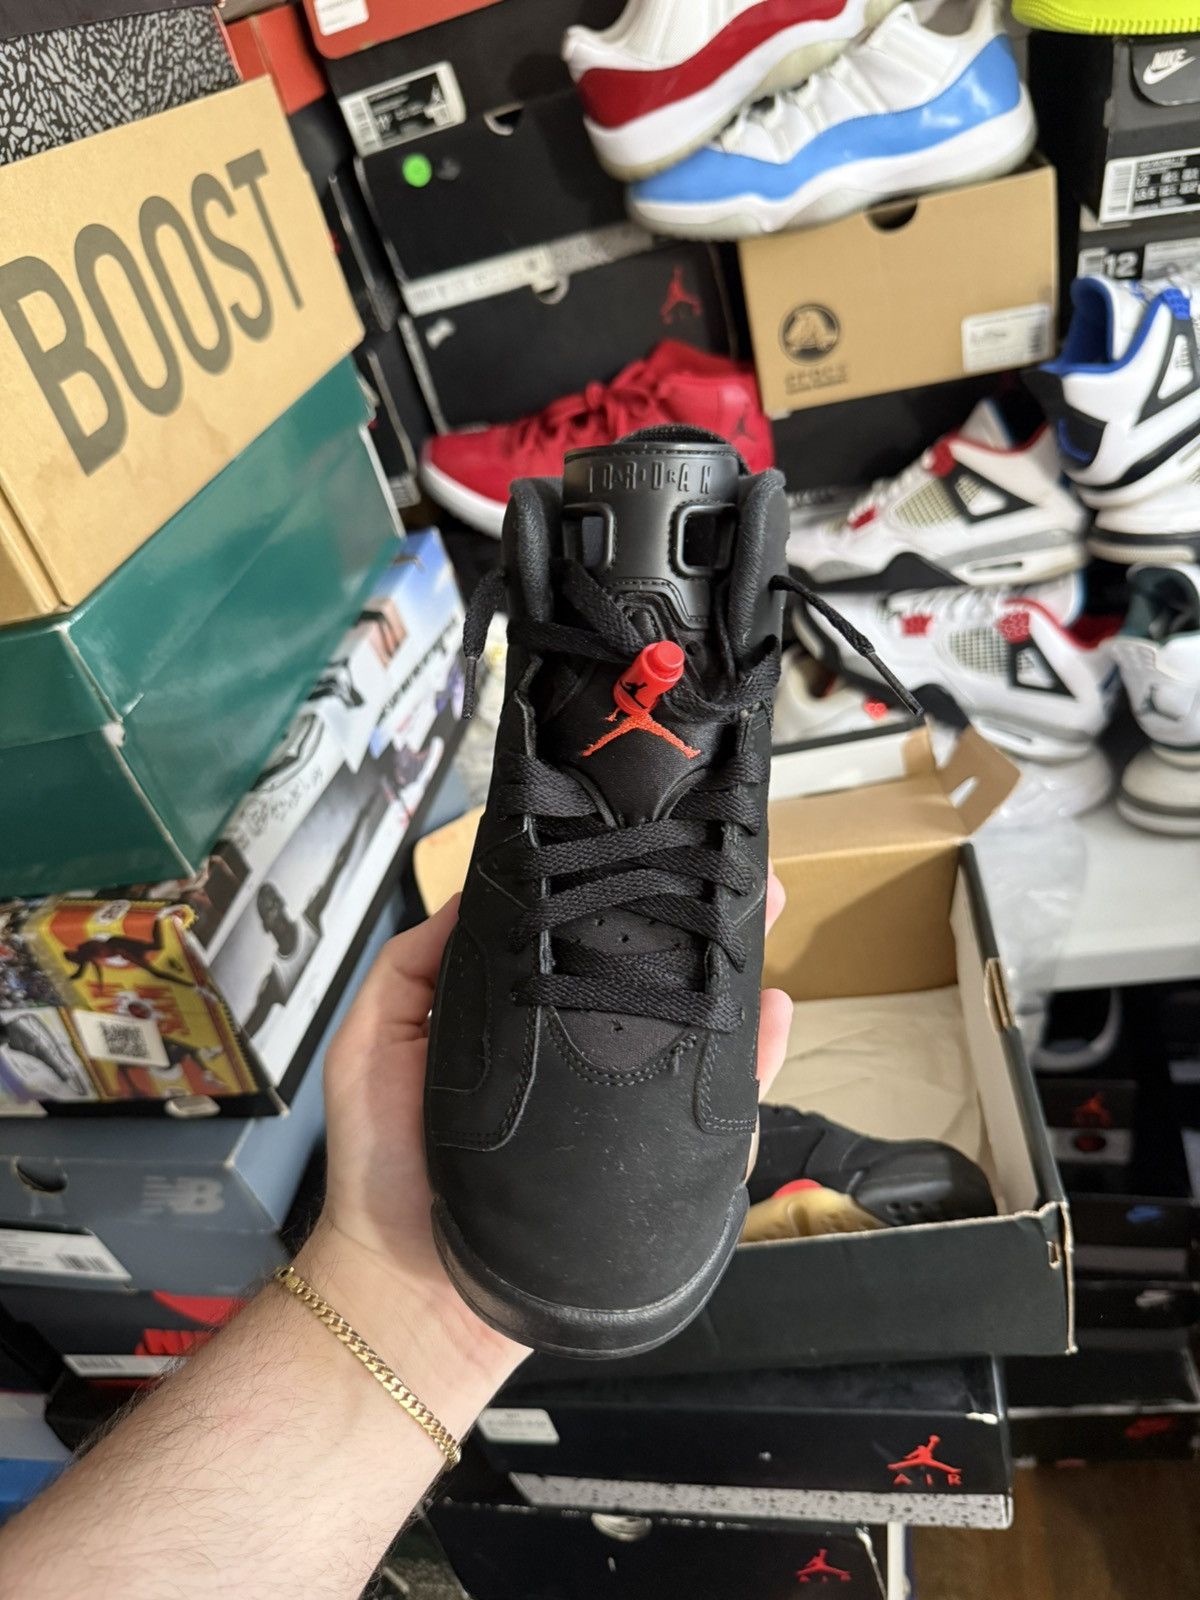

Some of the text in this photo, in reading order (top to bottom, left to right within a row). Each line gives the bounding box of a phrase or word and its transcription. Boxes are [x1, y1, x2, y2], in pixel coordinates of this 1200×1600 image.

[1103, 251, 1138, 278] 12
[0, 149, 305, 477] BOOST
[586, 461, 713, 495] JORDAN
[893, 1472, 963, 1486] AIR
